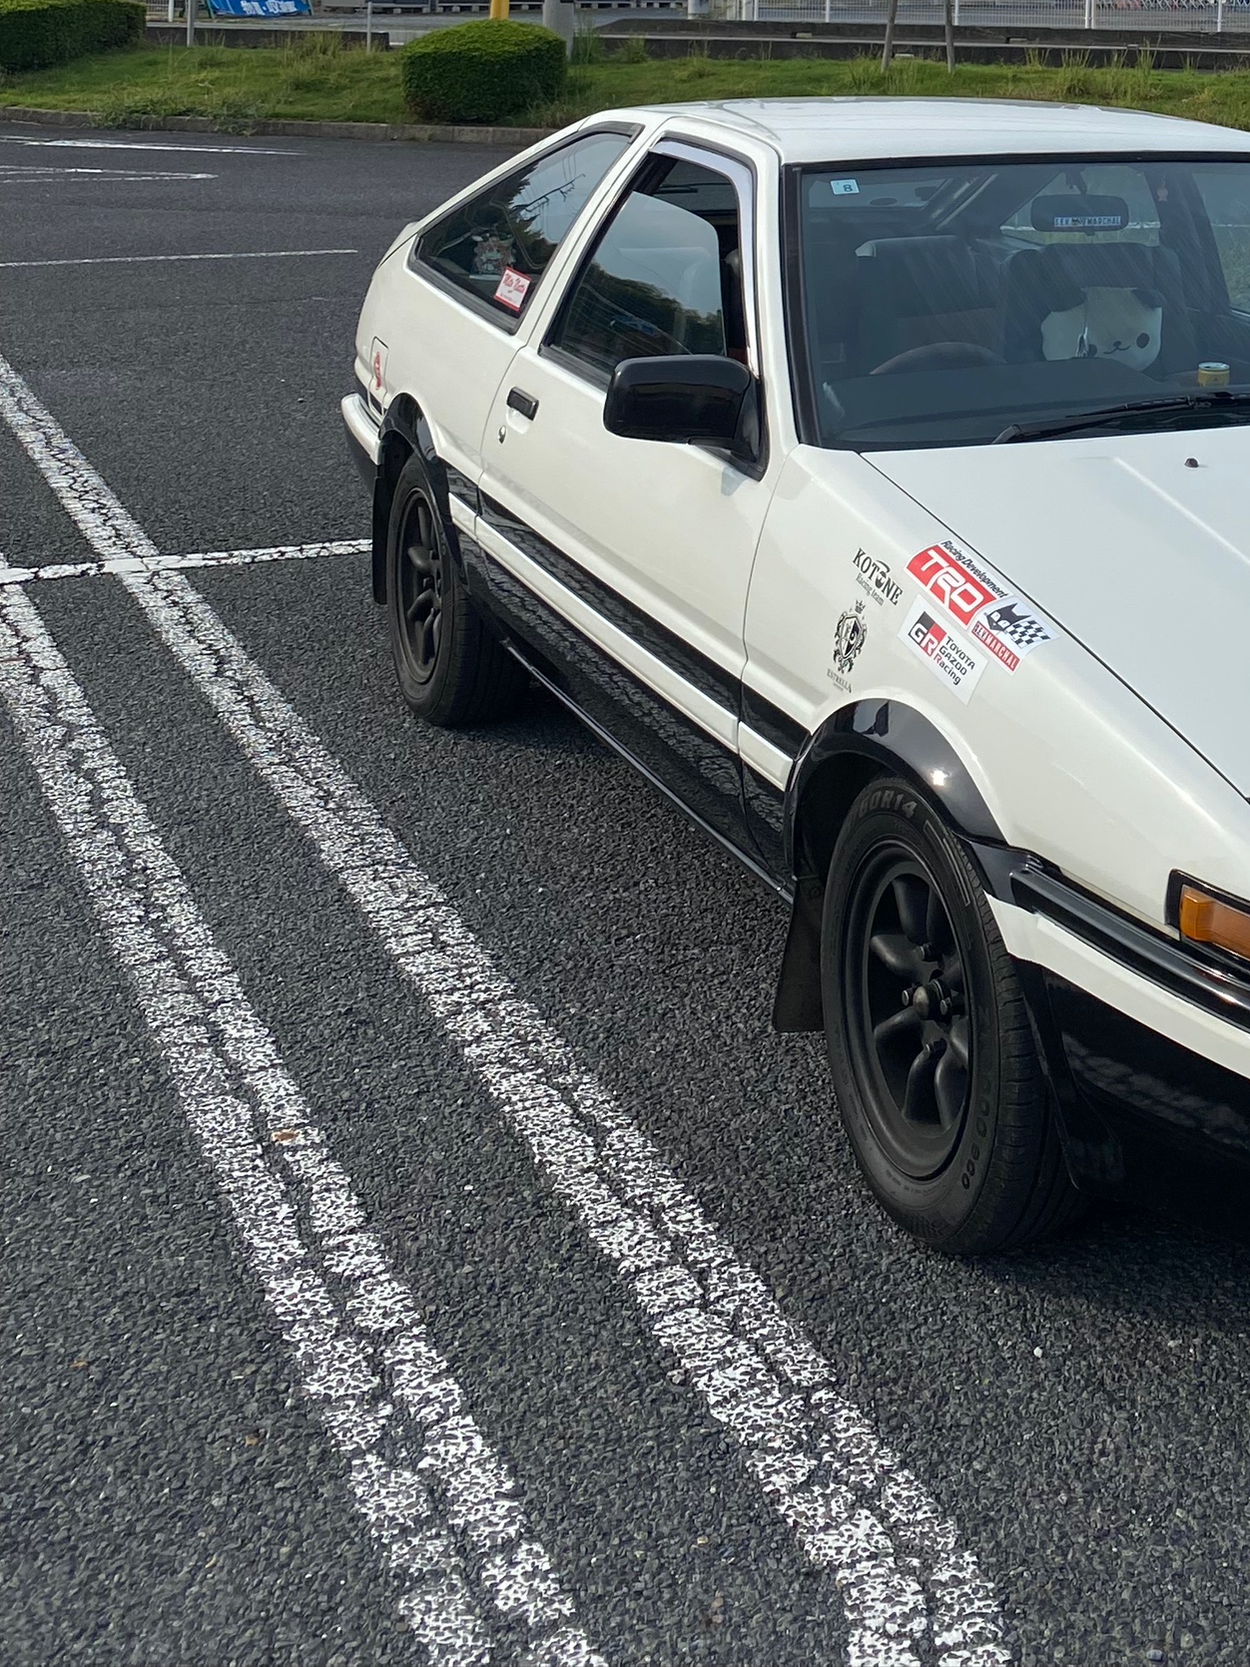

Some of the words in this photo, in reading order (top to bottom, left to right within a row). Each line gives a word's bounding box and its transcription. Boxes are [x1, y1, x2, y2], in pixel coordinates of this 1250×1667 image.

[920, 549, 984, 613] TRD
[941, 540, 965, 562] Racing
[961, 559, 1008, 598] Development
[908, 621, 940, 658] GR
[945, 636, 976, 671] TOYOTA
[983, 631, 1017, 670] MARCHAL
[932, 653, 962, 686] Racing
[938, 645, 968, 676] GAZOO
